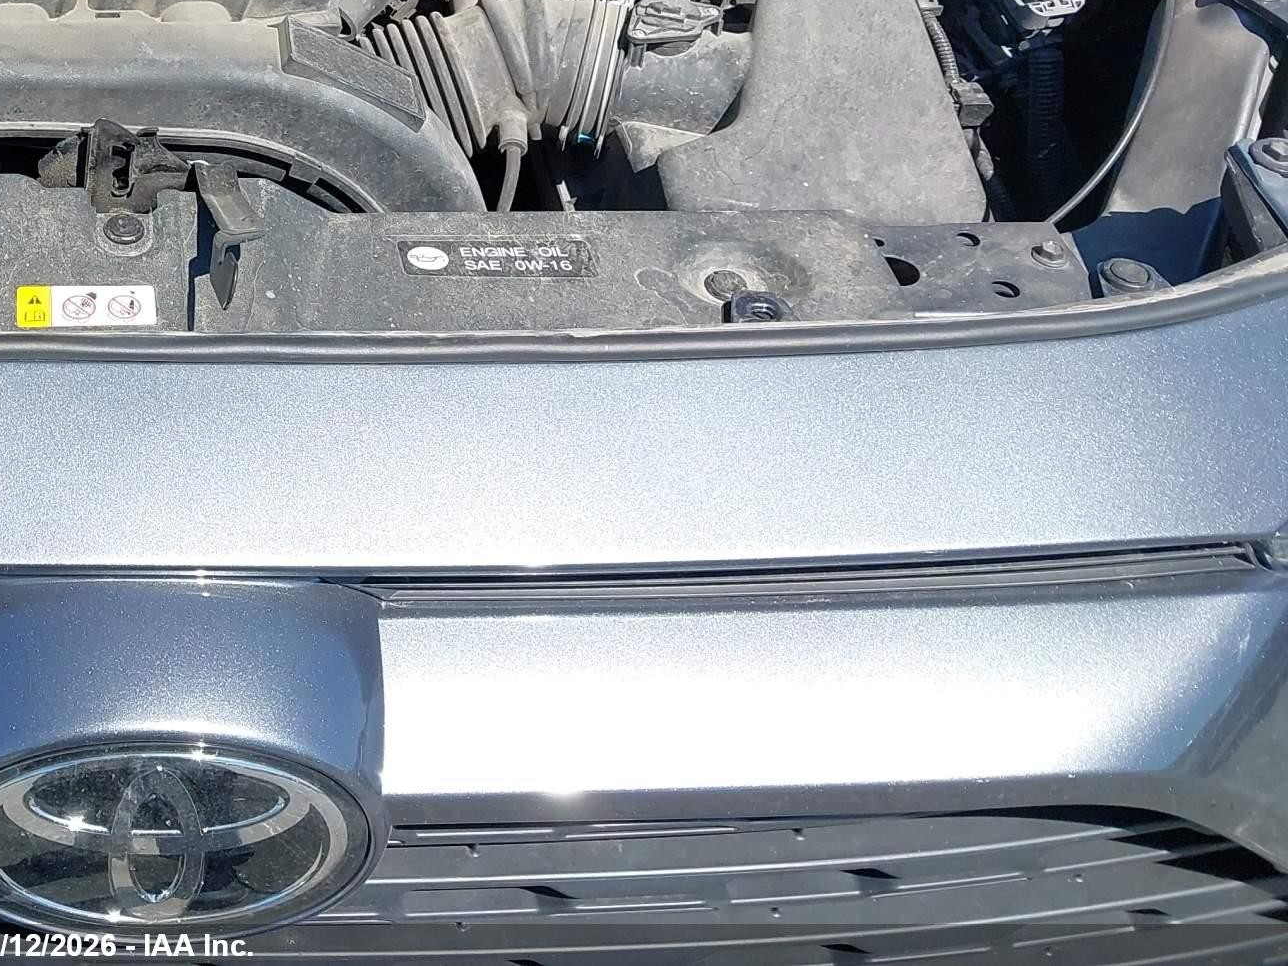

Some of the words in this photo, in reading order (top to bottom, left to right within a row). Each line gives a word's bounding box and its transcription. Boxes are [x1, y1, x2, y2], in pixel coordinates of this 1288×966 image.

[460, 247, 529, 257] ENGINE
[538, 247, 569, 257] OIL
[465, 260, 503, 271] SAE
[515, 260, 572, 271] 0W-16
